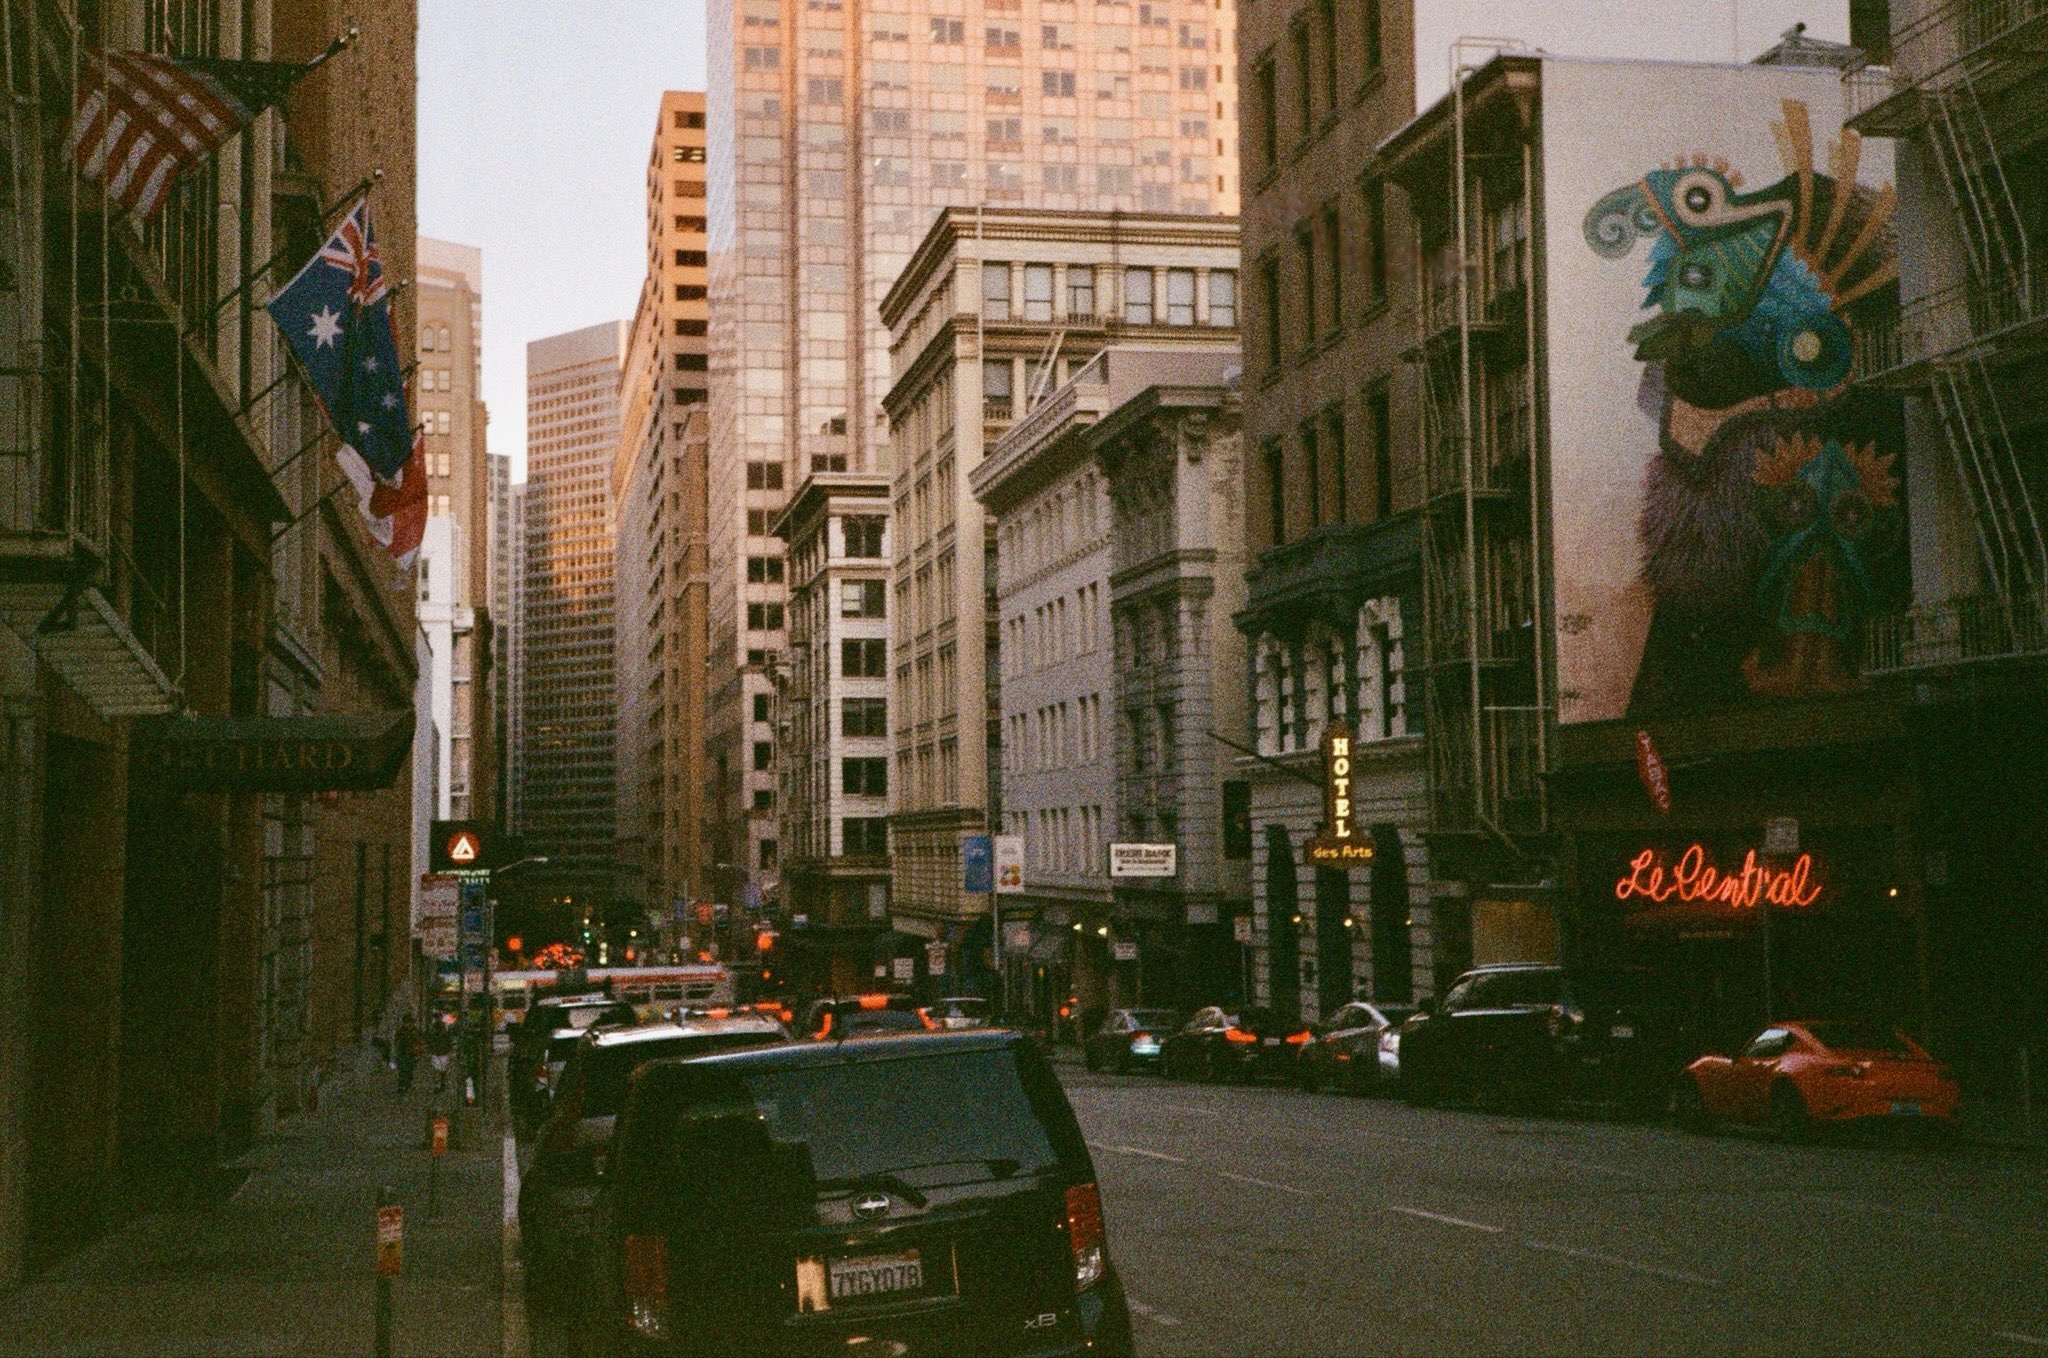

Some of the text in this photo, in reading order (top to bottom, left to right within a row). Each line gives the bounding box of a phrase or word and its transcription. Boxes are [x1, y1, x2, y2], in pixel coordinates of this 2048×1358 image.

[1332, 738, 1350, 837] HOTEL
[1313, 845, 1373, 858] des Arts
[1615, 849, 1676, 902] Le
[1024, 1312, 1057, 1330] xB
